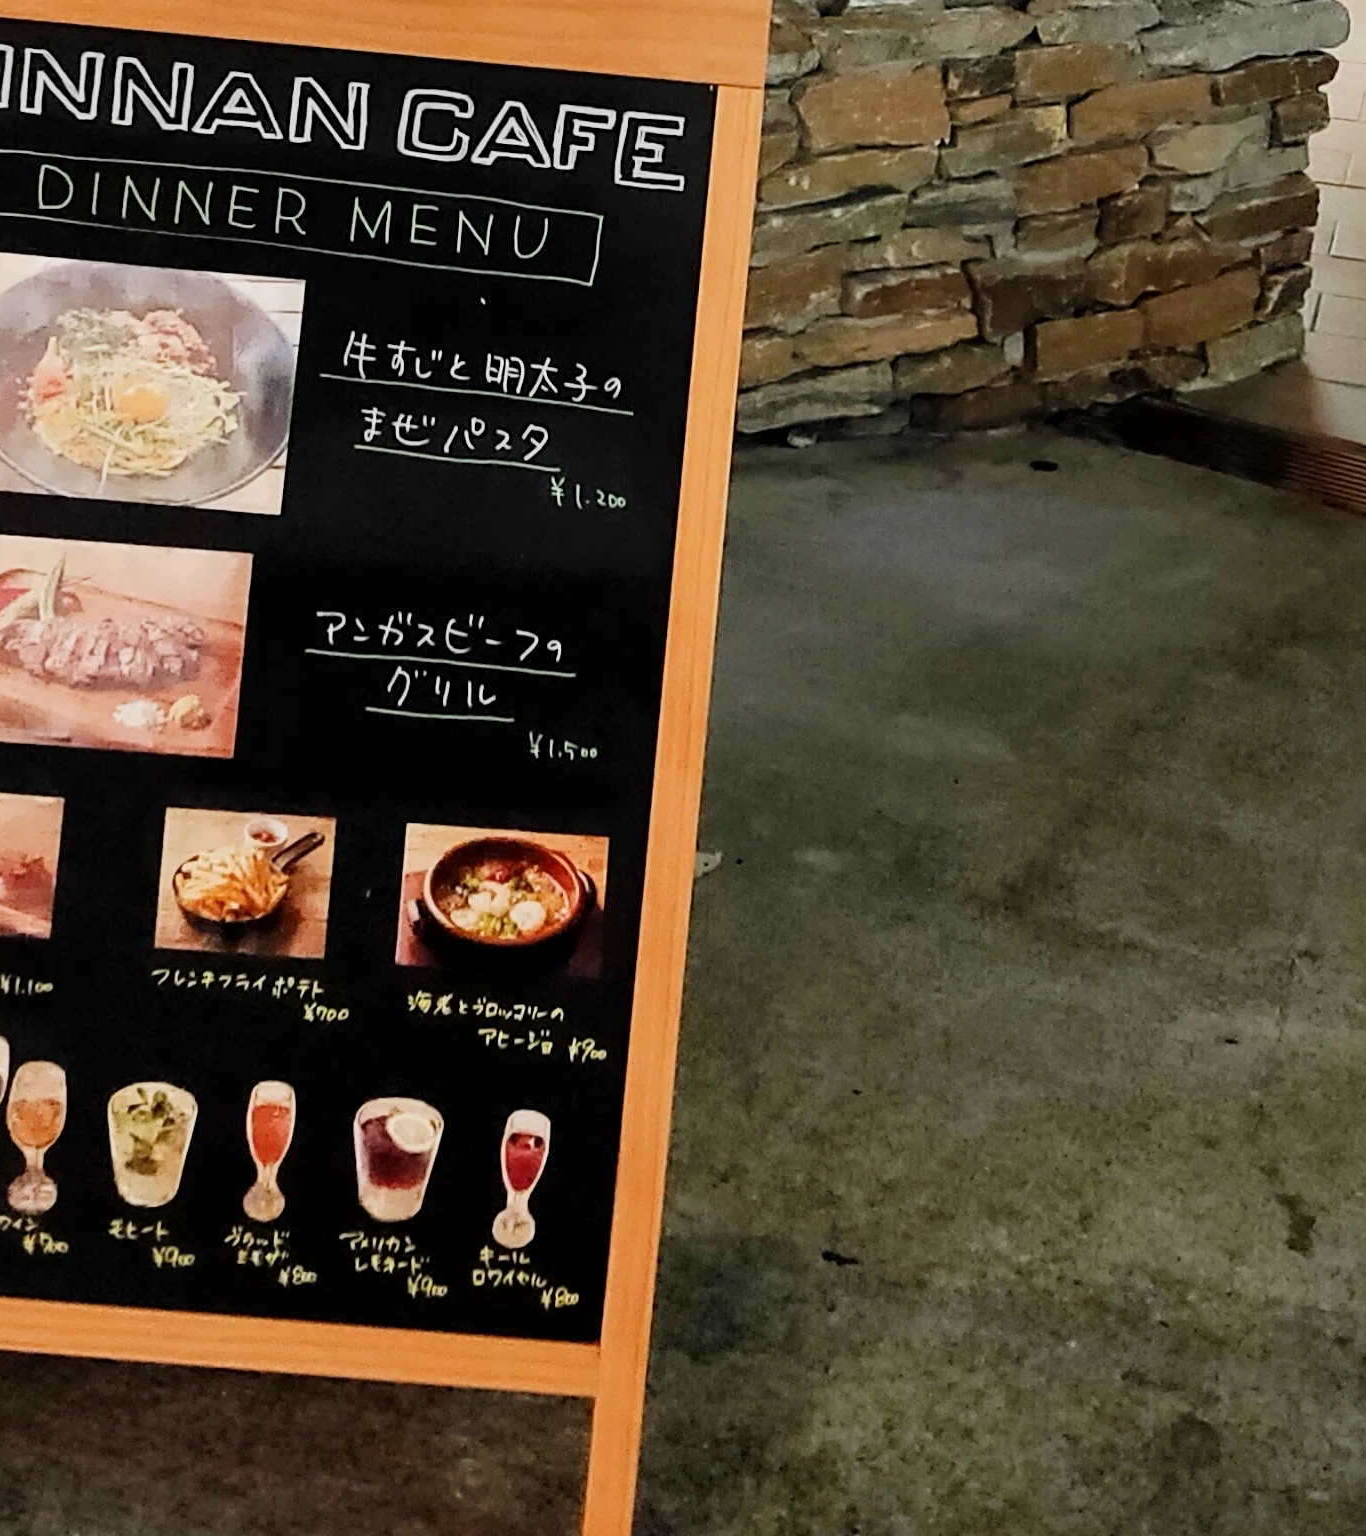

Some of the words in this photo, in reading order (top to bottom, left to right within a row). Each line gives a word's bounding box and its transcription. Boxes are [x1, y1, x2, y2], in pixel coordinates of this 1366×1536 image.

[397, 89, 687, 193] CAFE
[36, 164, 307, 238] DINNER
[349, 196, 551, 260] MENU
[343, 330, 622, 402] 牛すじと明太子の
[361, 406, 549, 461] まぜパスタ
[316, 611, 563, 662] アンガスビーフの
[387, 666, 496, 706] グリル
